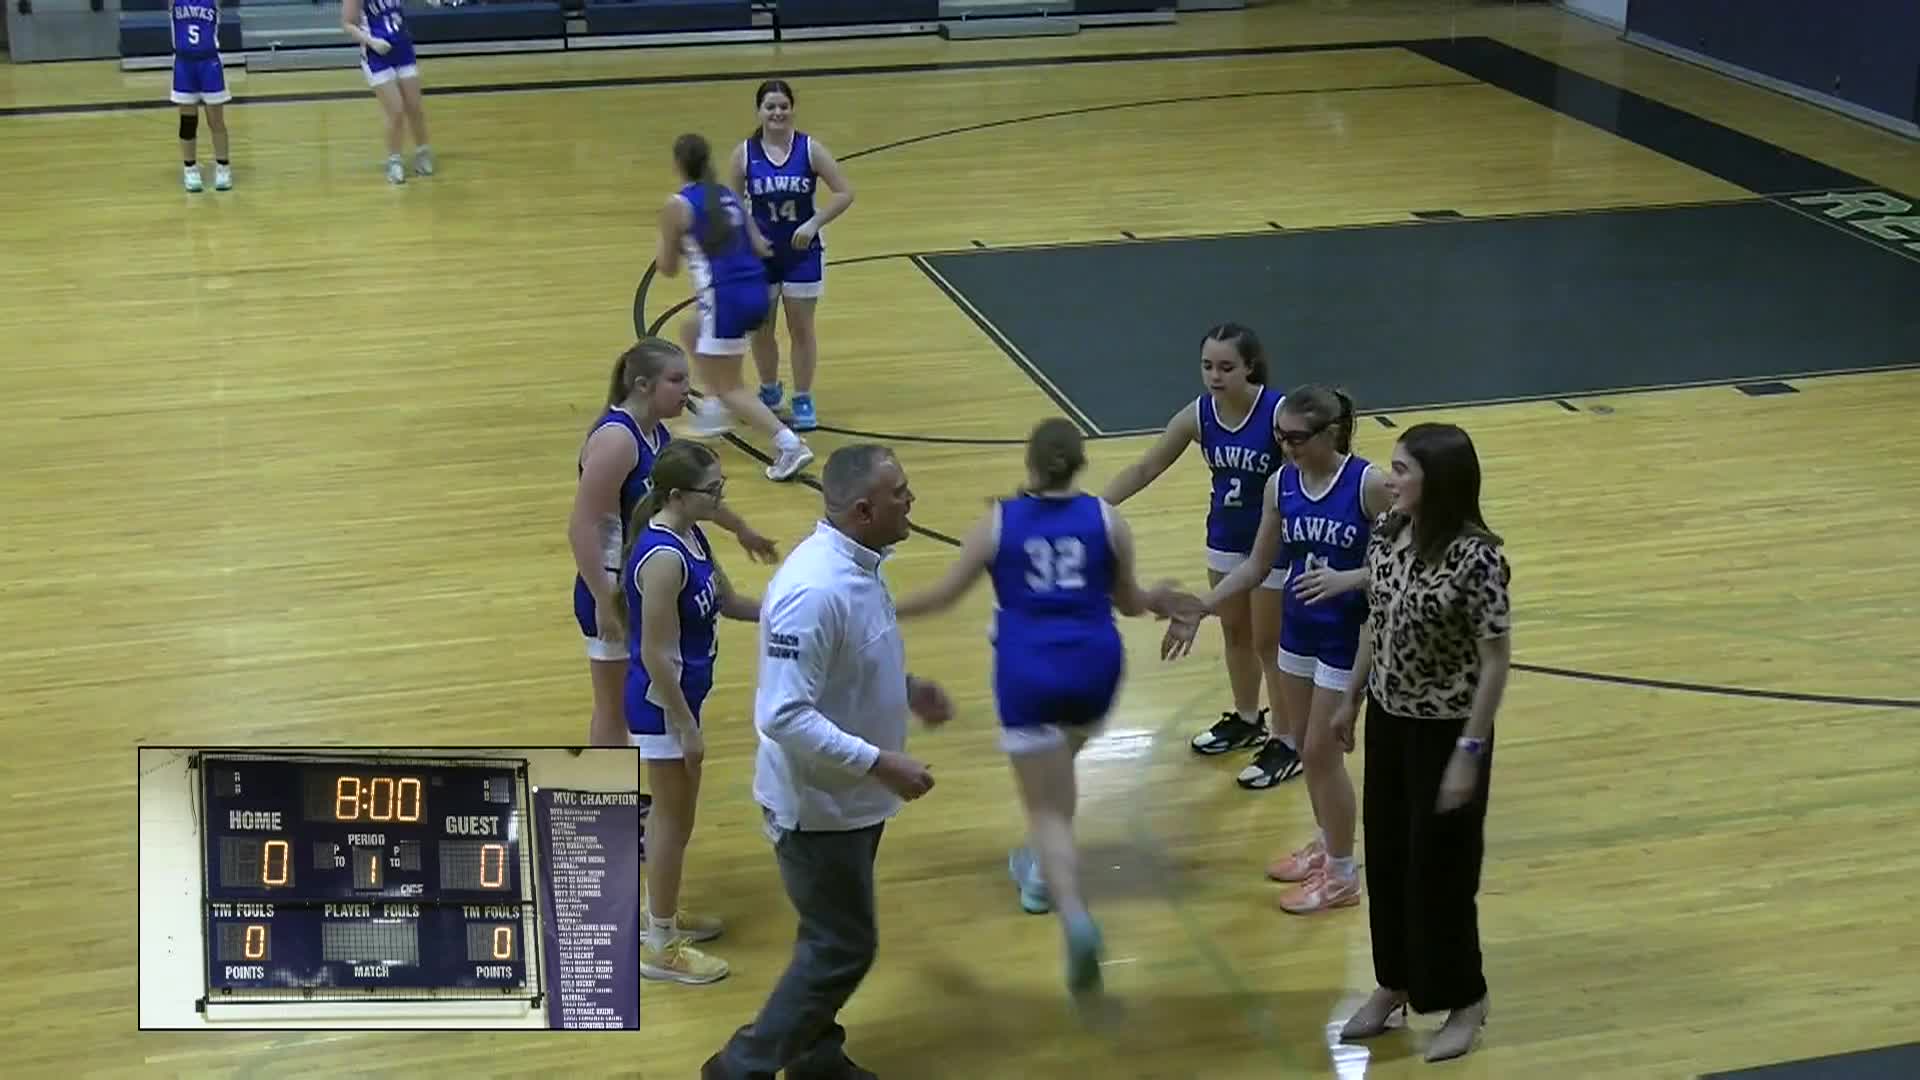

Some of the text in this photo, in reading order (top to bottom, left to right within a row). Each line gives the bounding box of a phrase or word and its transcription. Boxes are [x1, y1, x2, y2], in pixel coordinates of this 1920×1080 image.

[174, 5, 214, 21] HAWKS
[187, 25, 200, 44] 5
[752, 175, 811, 195] HAWKS
[767, 200, 798, 222] 14
[1790, 191, 1920, 252] RE
[1223, 477, 1243, 507] 2
[1280, 515, 1358, 549] HAWKS
[1023, 534, 1087, 594] 32
[336, 776, 422, 821] 8:00
[553, 791, 638, 806] MVC CHAMPION
[228, 810, 283, 830] HOME
[445, 815, 500, 837] GUEST
[333, 844, 340, 855] P
[347, 833, 386, 846] PERIOD
[393, 846, 400, 856] P
[262, 839, 290, 885] 0
[333, 856, 345, 867] TO
[370, 855, 377, 884] 1
[480, 843, 504, 888] 0
[212, 903, 275, 918] TM FOULS
[324, 904, 421, 918] PLAYER FOULS
[462, 906, 520, 919] TM FOULS
[244, 925, 266, 959] 0
[493, 926, 512, 959] 0
[225, 966, 265, 979] POINTS
[354, 965, 390, 978] MATCH
[475, 966, 513, 979] POINTS
